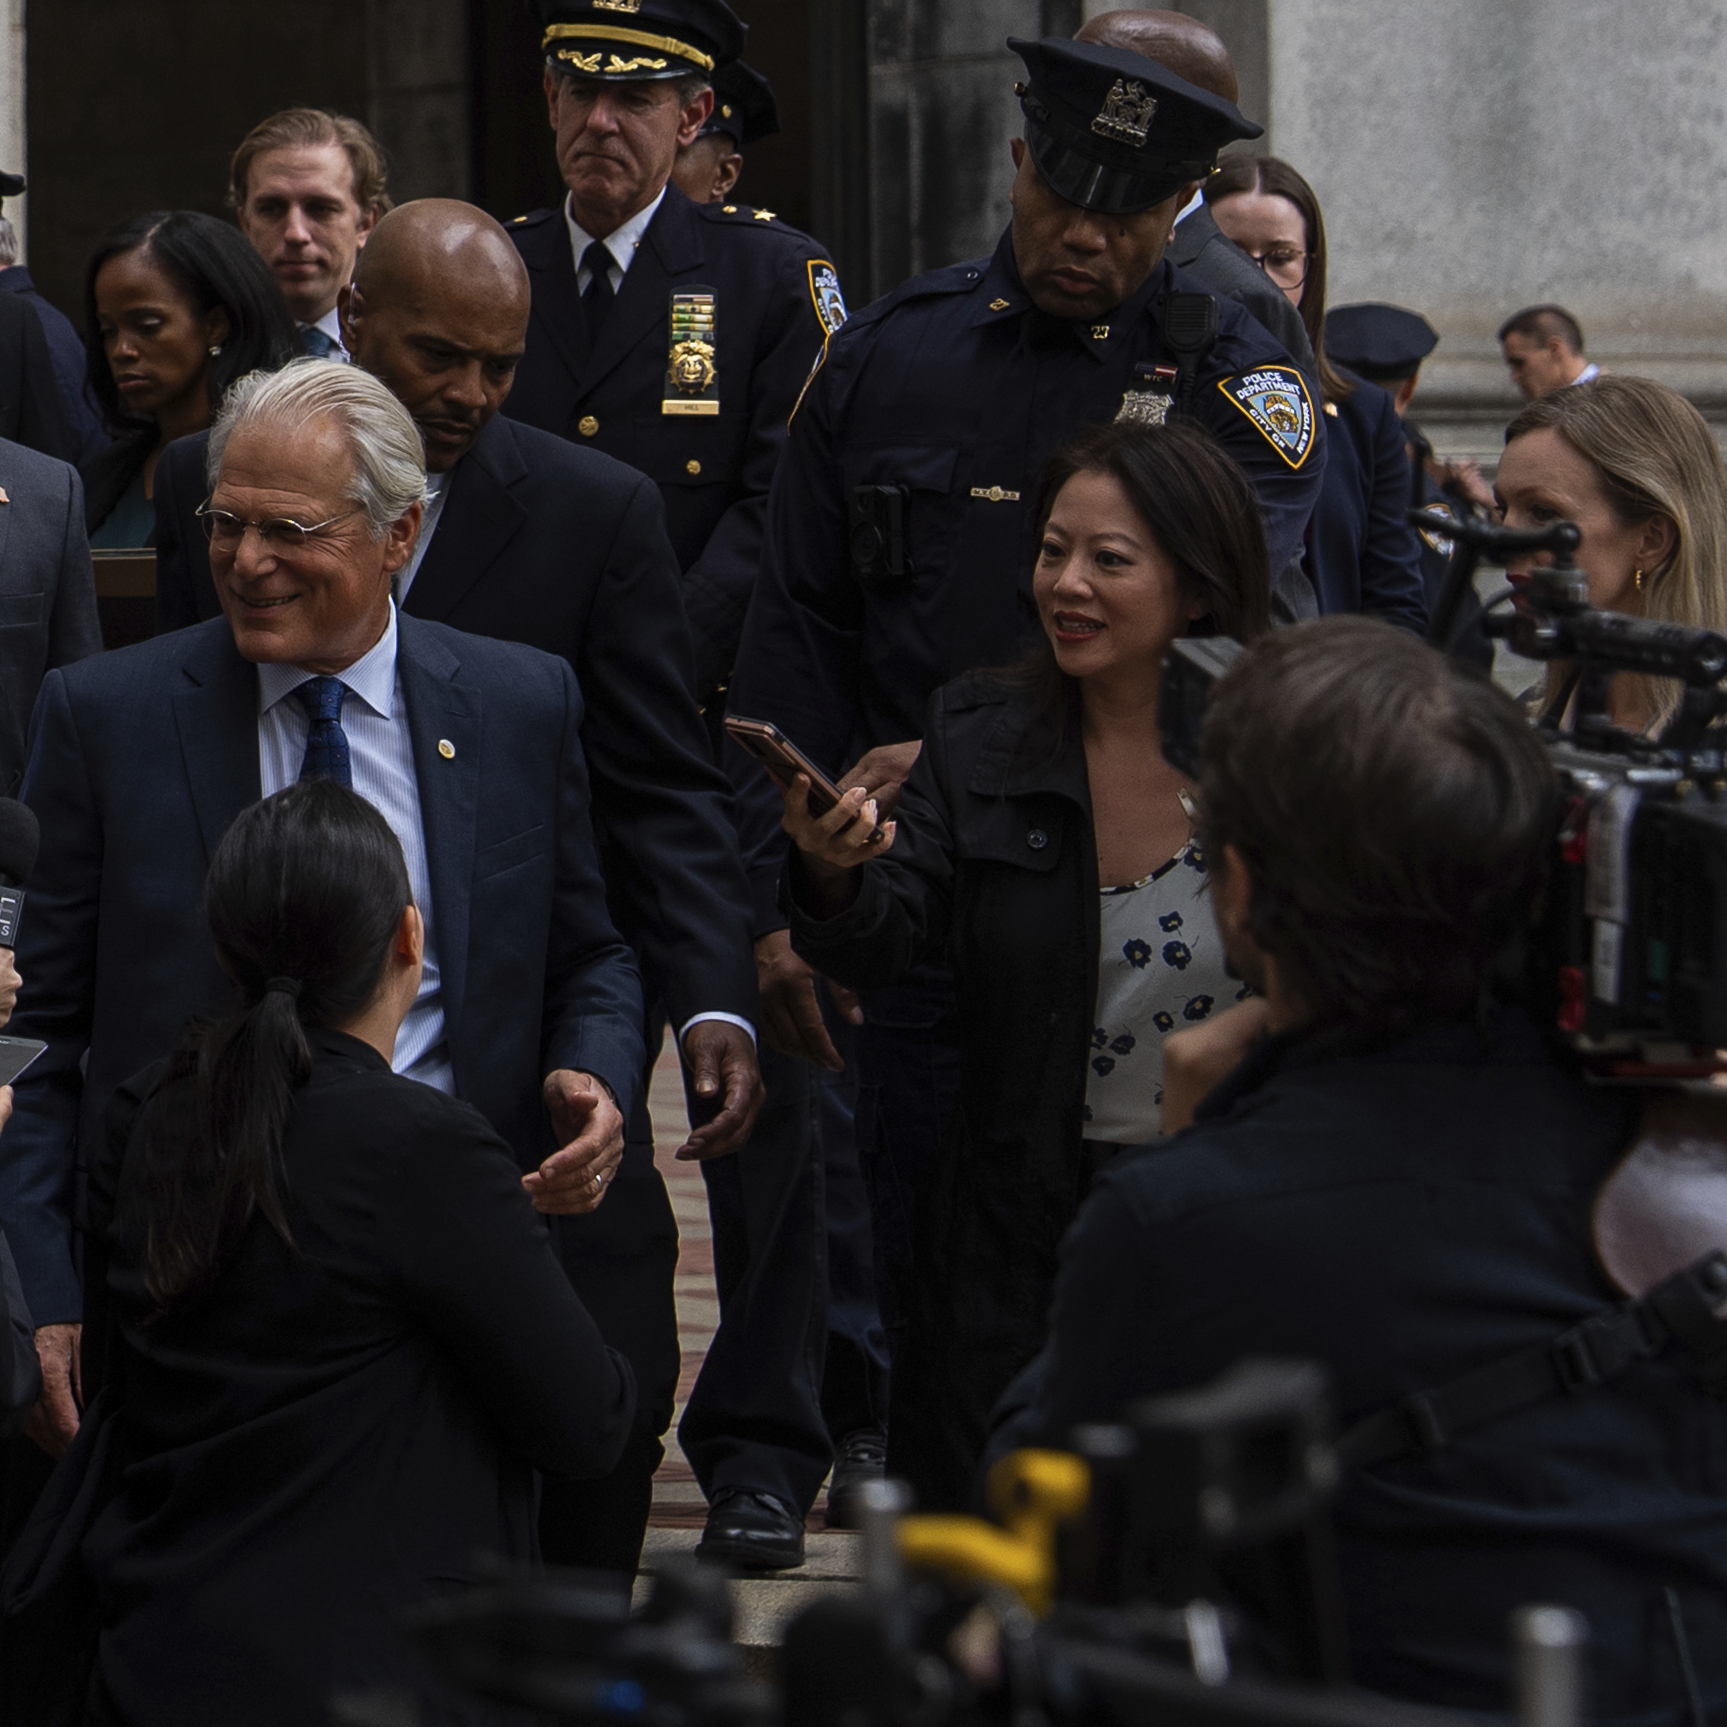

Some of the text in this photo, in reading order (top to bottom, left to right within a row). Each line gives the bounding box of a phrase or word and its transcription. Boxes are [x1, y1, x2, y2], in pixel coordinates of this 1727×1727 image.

[1091, 325, 1110, 339] 27
[1242, 371, 1283, 386] POLICE
[1236, 381, 1300, 400] DEPARTMENT
[1249, 409, 1272, 431] CITY
[1296, 402, 1311, 454] NEW YORK
